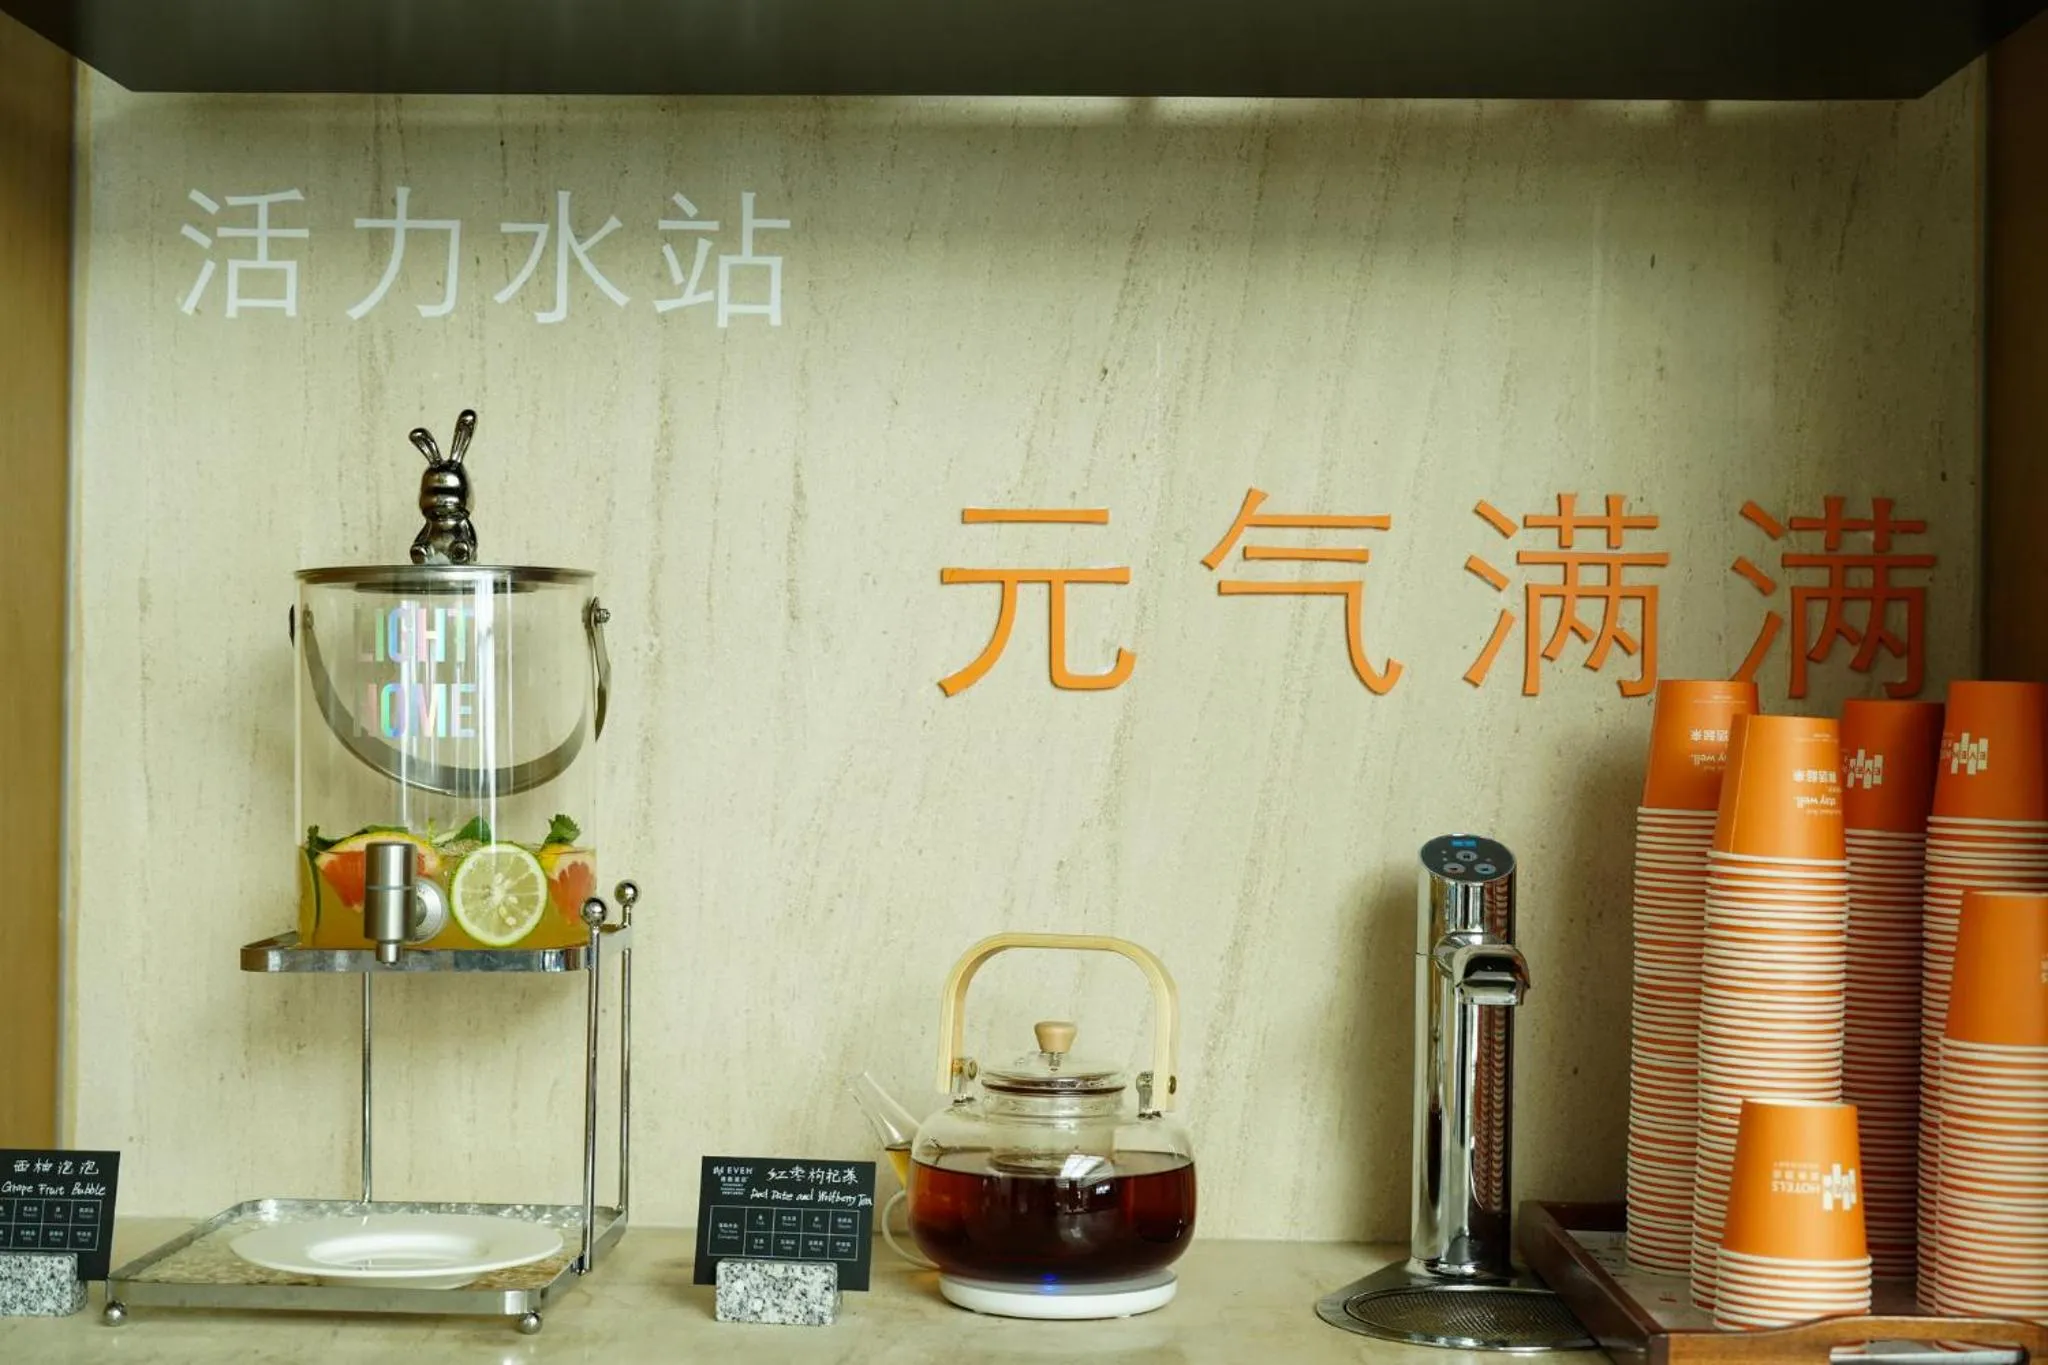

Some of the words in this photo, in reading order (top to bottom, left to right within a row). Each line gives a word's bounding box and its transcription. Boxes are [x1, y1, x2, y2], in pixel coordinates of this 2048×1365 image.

[179, 186, 791, 328] 活力水站
[938, 488, 1936, 699] 元气满满
